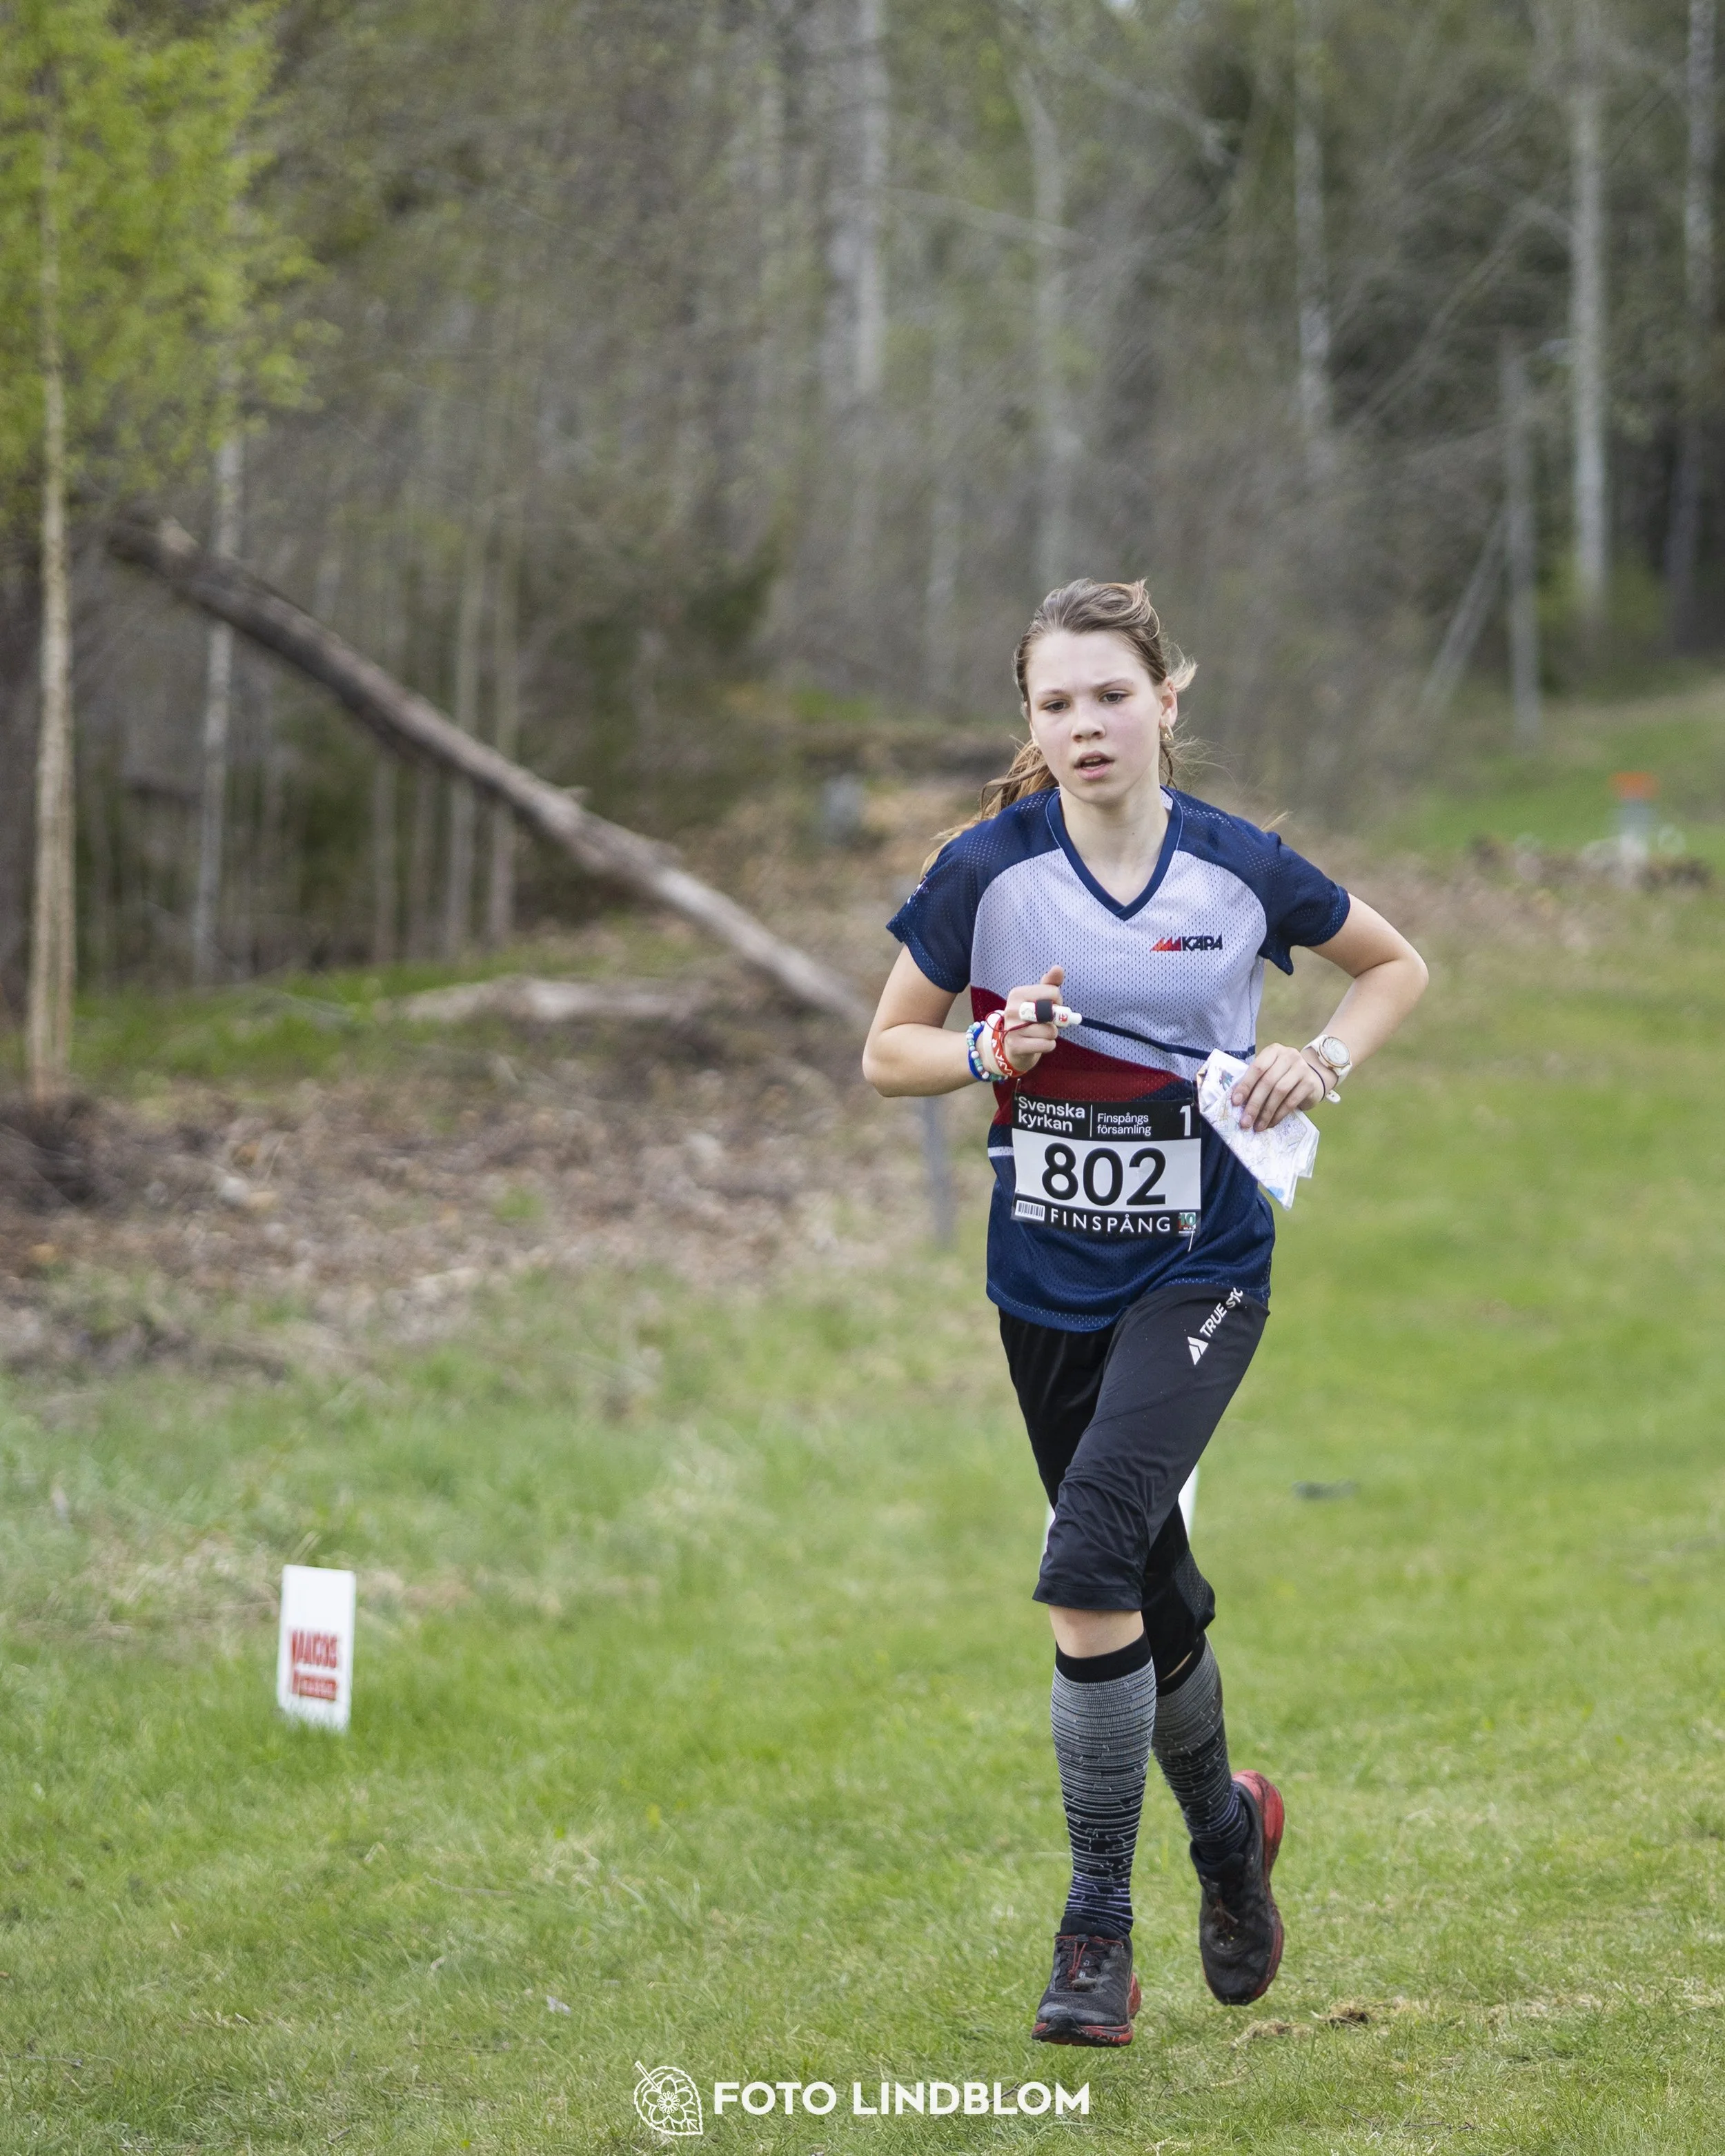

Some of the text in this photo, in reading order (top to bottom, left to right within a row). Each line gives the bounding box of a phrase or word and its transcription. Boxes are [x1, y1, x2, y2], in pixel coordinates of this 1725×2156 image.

[1018, 1096, 1085, 1118] Svenska
[1098, 1112, 1149, 1125] Finspångs
[1018, 1109, 1073, 1132] kyrkan
[1097, 1124, 1152, 1137] församling
[1179, 1105, 1192, 1136] 1
[1042, 1142, 1166, 1207] 802
[1050, 1207, 1171, 1233] FINSPÅNG
[1200, 1303, 1228, 1337] TRUE
